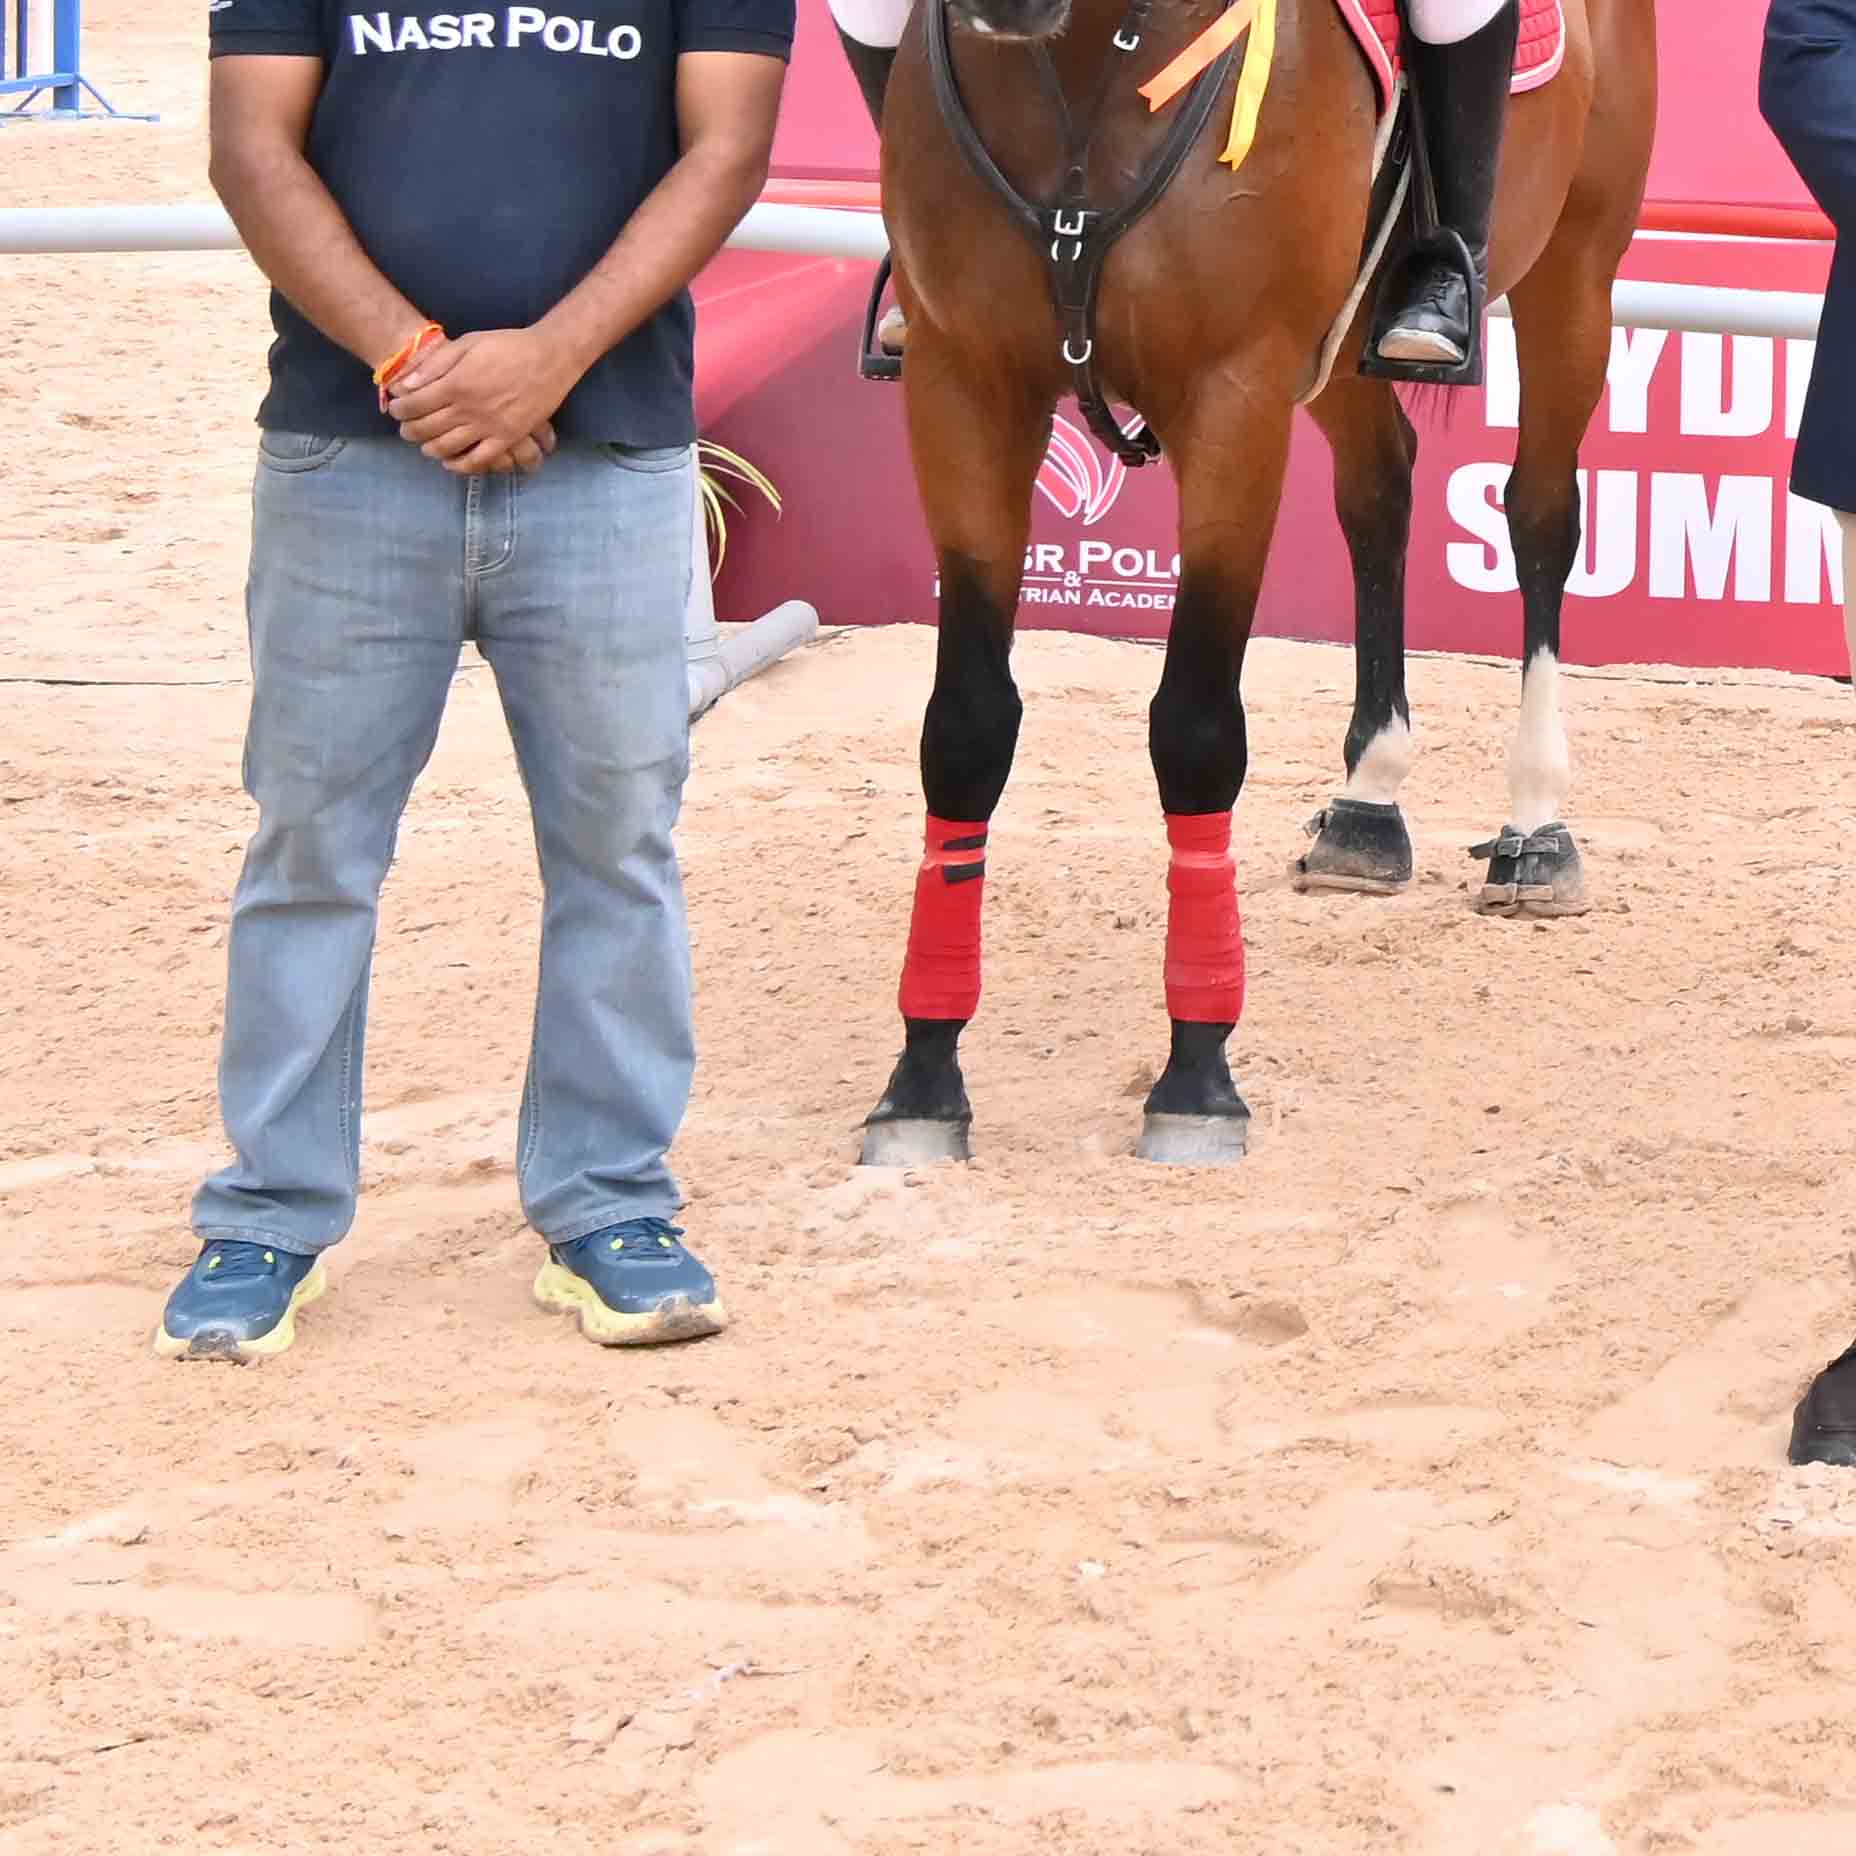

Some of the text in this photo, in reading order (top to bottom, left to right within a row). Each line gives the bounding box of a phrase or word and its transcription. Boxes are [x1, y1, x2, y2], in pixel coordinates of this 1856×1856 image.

[350, 5, 643, 61] NASR POLO
[1063, 571, 1082, 588] &
